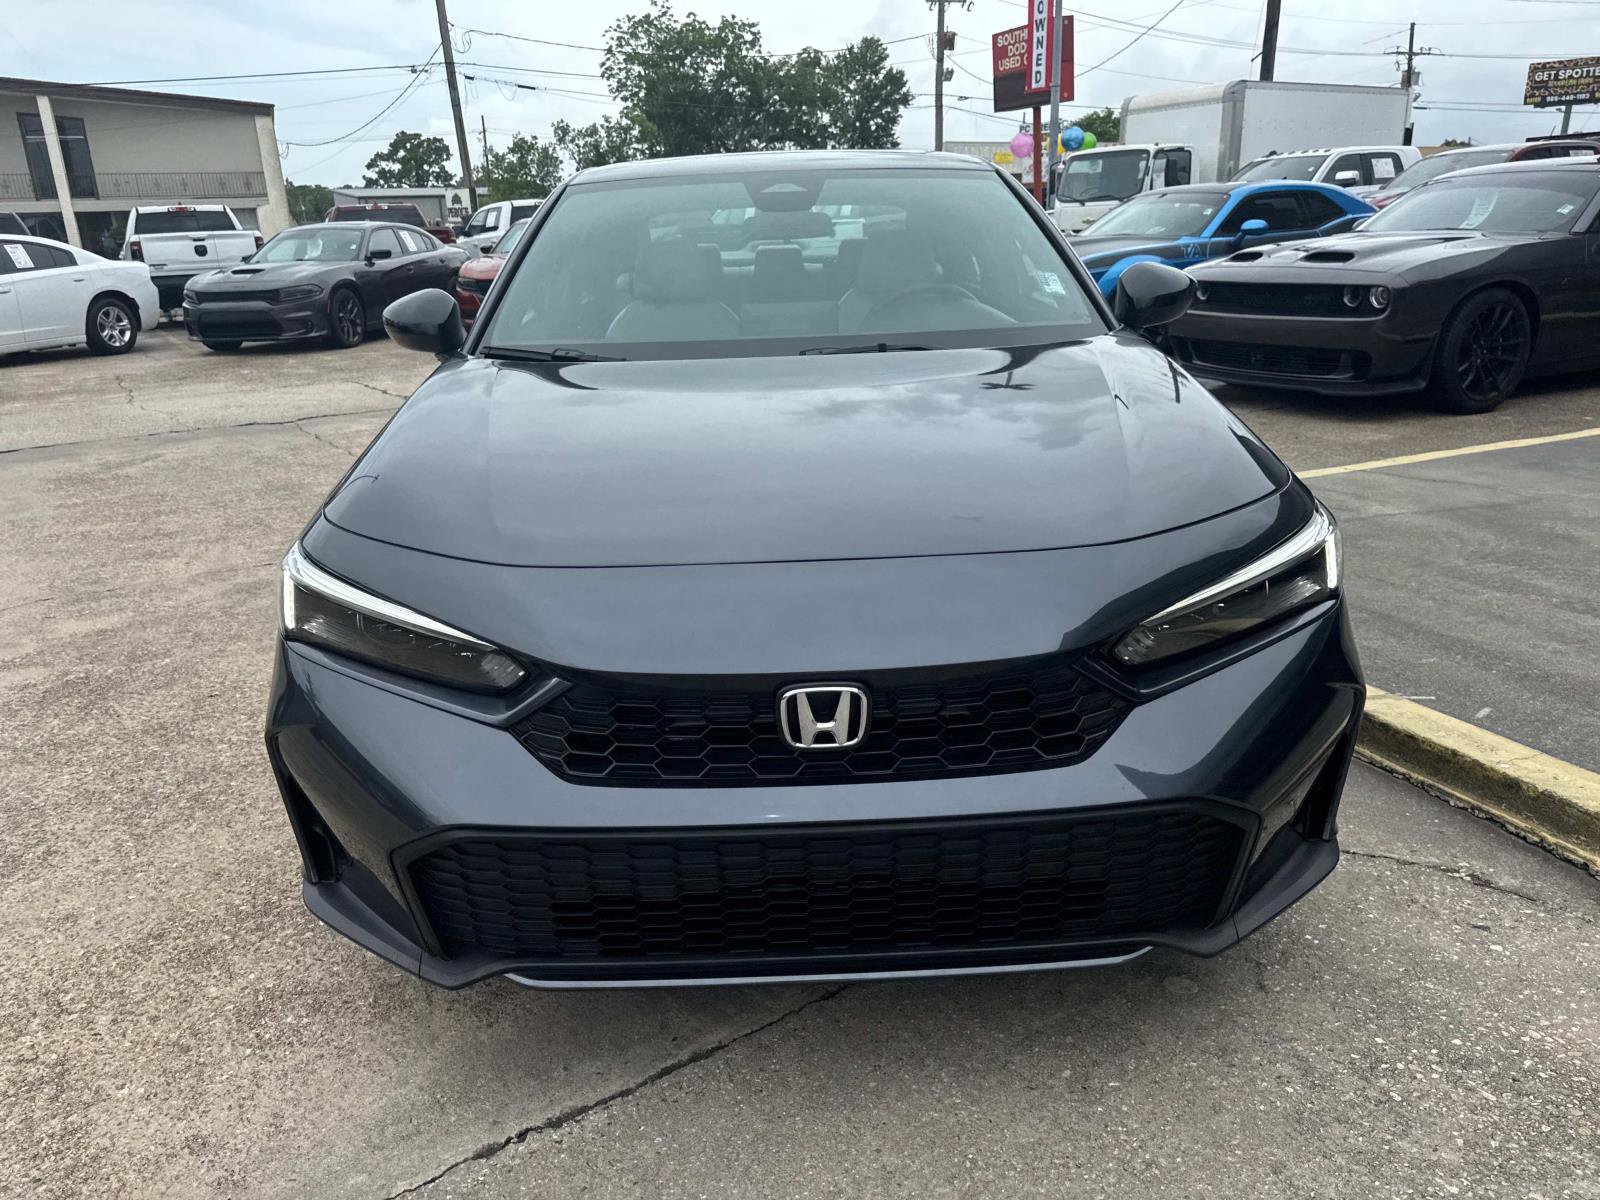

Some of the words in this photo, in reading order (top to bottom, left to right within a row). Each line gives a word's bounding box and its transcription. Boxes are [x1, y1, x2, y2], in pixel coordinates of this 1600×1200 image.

[1034, 1, 1046, 84] OWNED
[998, 55, 1021, 70] USED
[1535, 71, 1556, 81] GET
